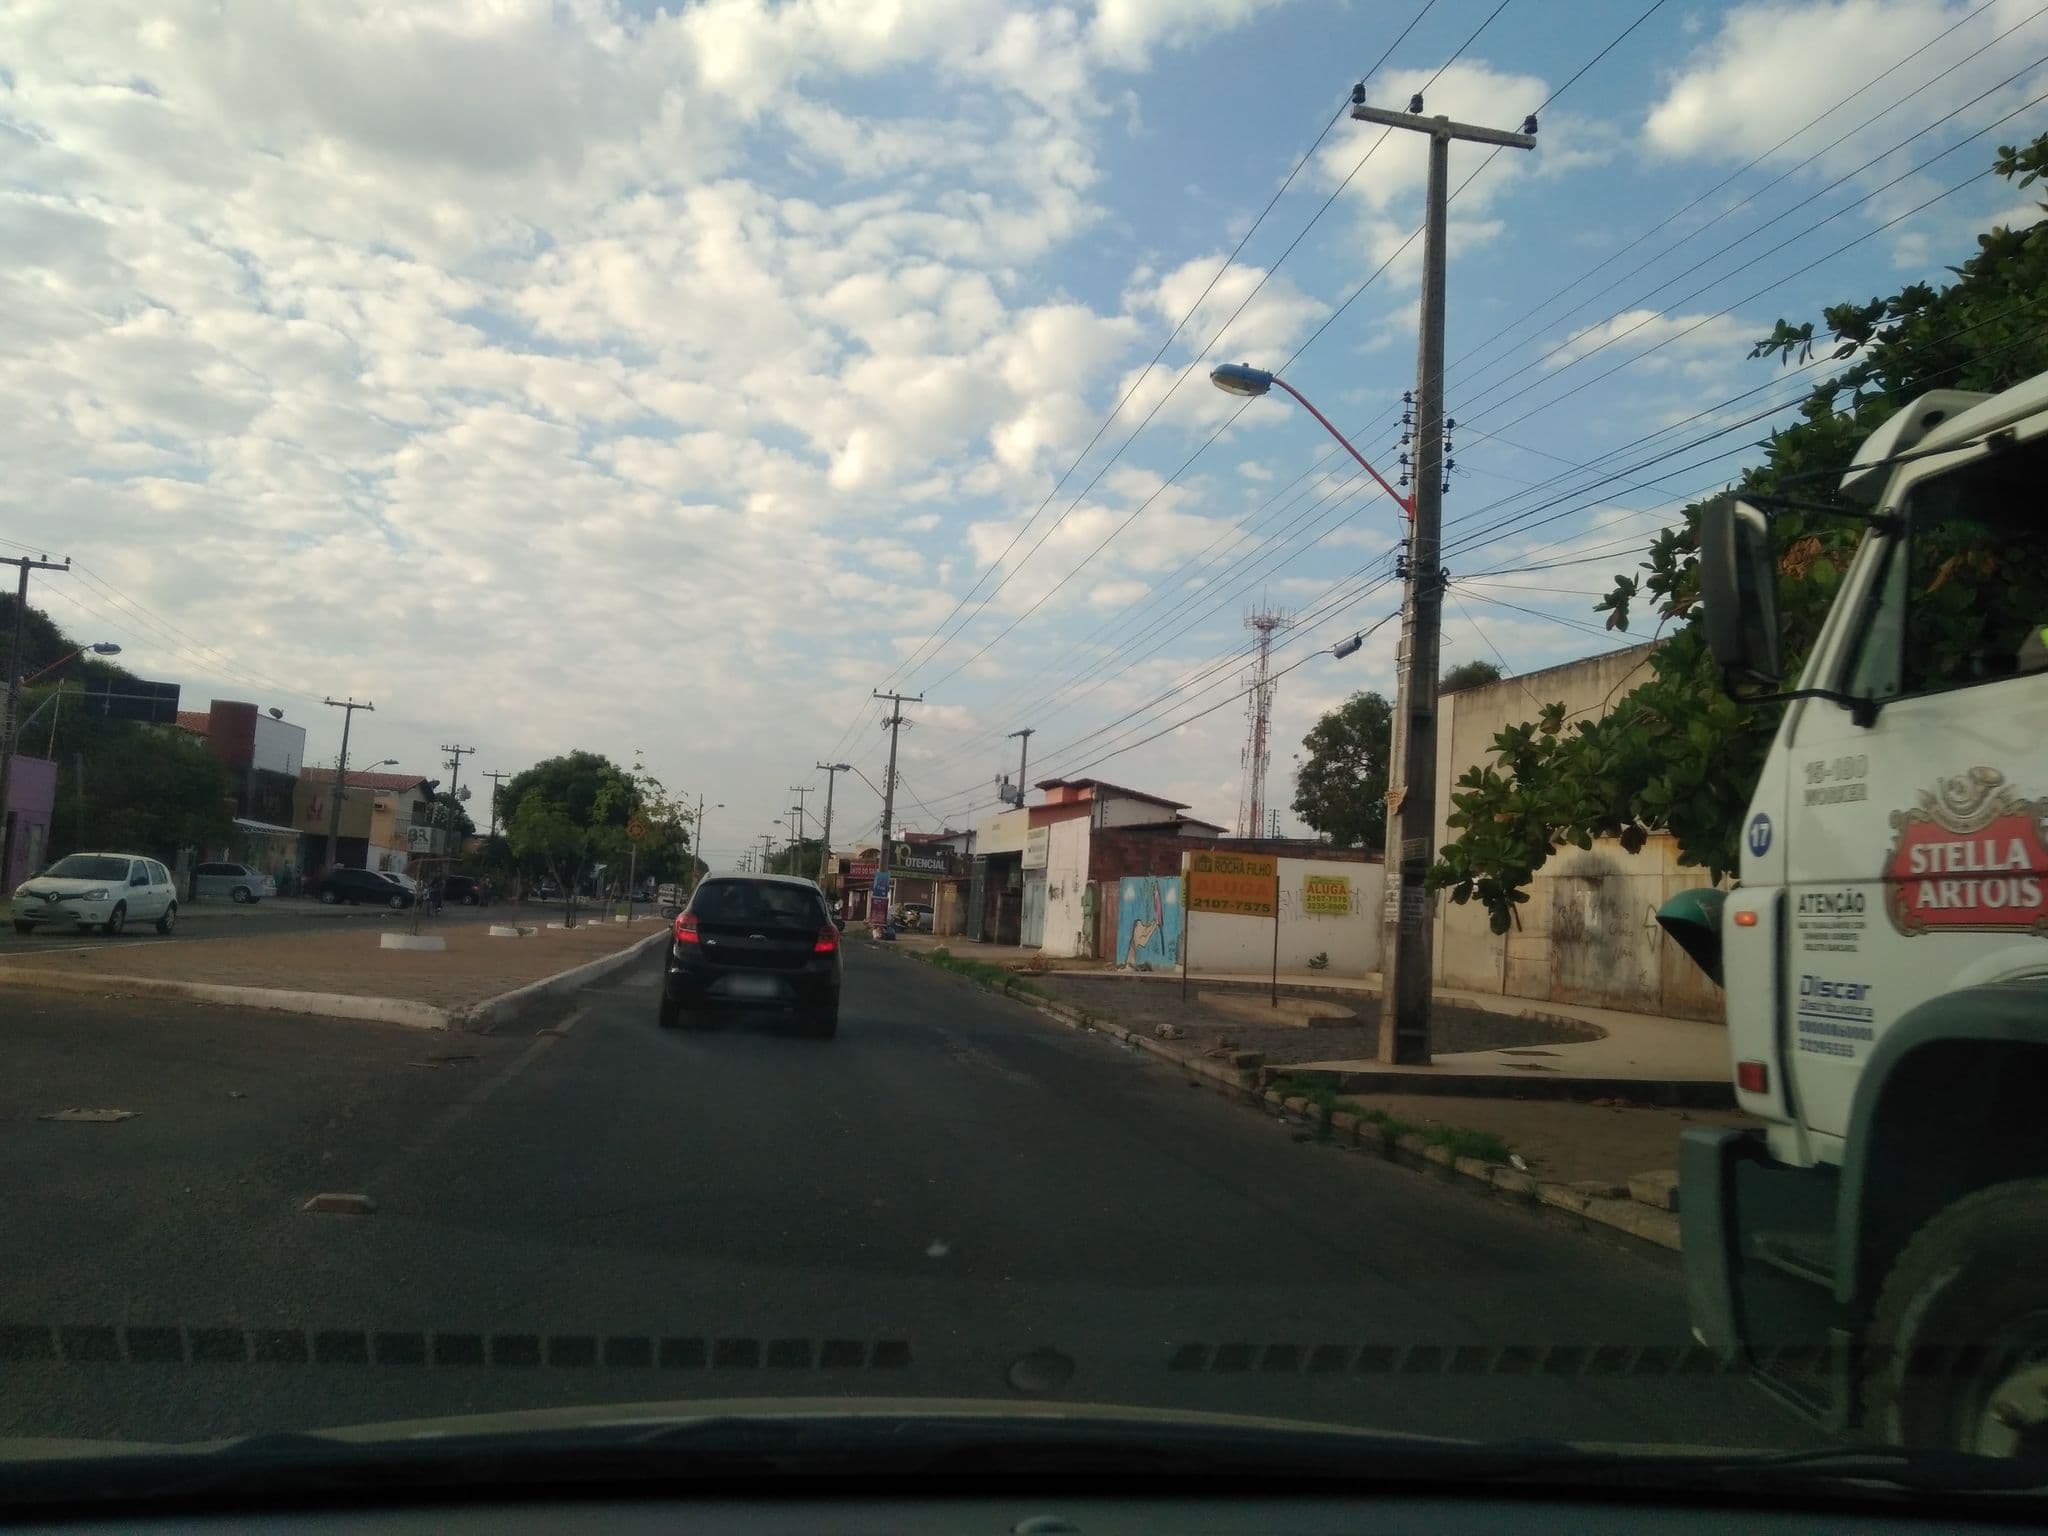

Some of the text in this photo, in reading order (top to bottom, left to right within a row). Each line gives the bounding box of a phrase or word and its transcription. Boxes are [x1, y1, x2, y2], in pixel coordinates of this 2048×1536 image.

[1751, 823, 1770, 848] 17
[1910, 838, 2032, 874] STELLA
[1307, 883, 1347, 896] ALUGA
[1916, 878, 2043, 909] ARTOIS
[1799, 975, 1873, 1001] Discar
